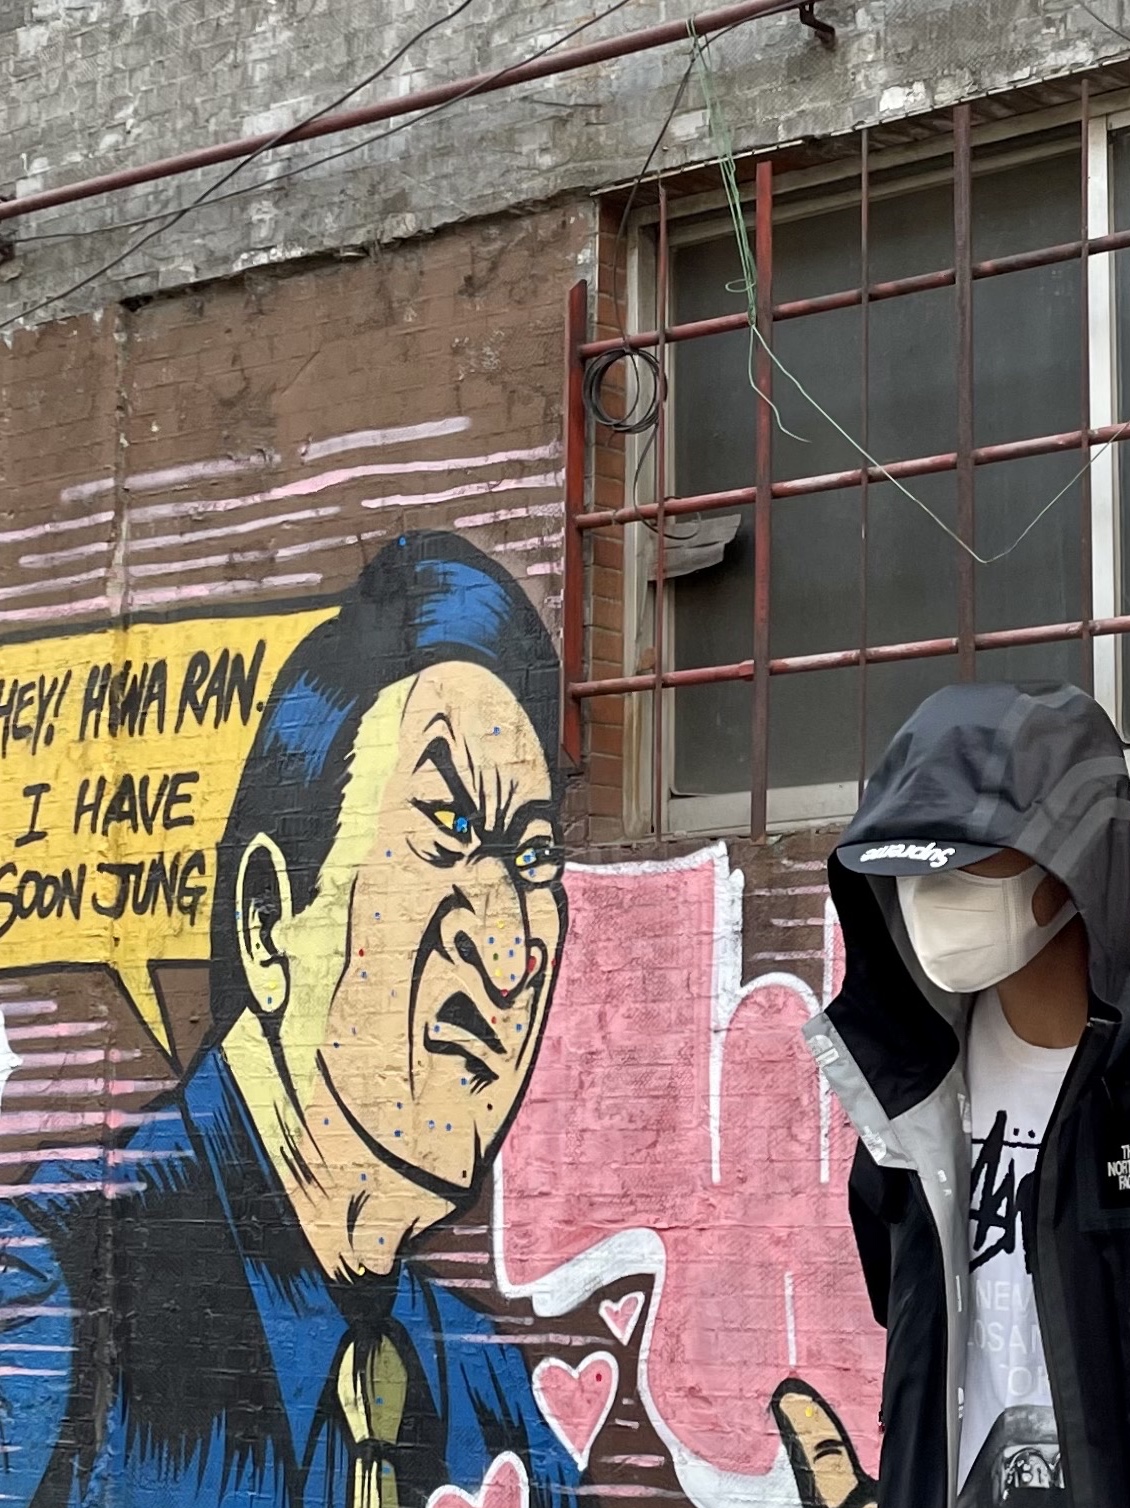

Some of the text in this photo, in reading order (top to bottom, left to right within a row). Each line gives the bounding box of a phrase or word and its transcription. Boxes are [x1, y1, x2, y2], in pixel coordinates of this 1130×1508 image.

[79, 659, 168, 742] HWA
[14, 770, 200, 848] I HAVE
[0, 850, 207, 938] SOON JUNG
